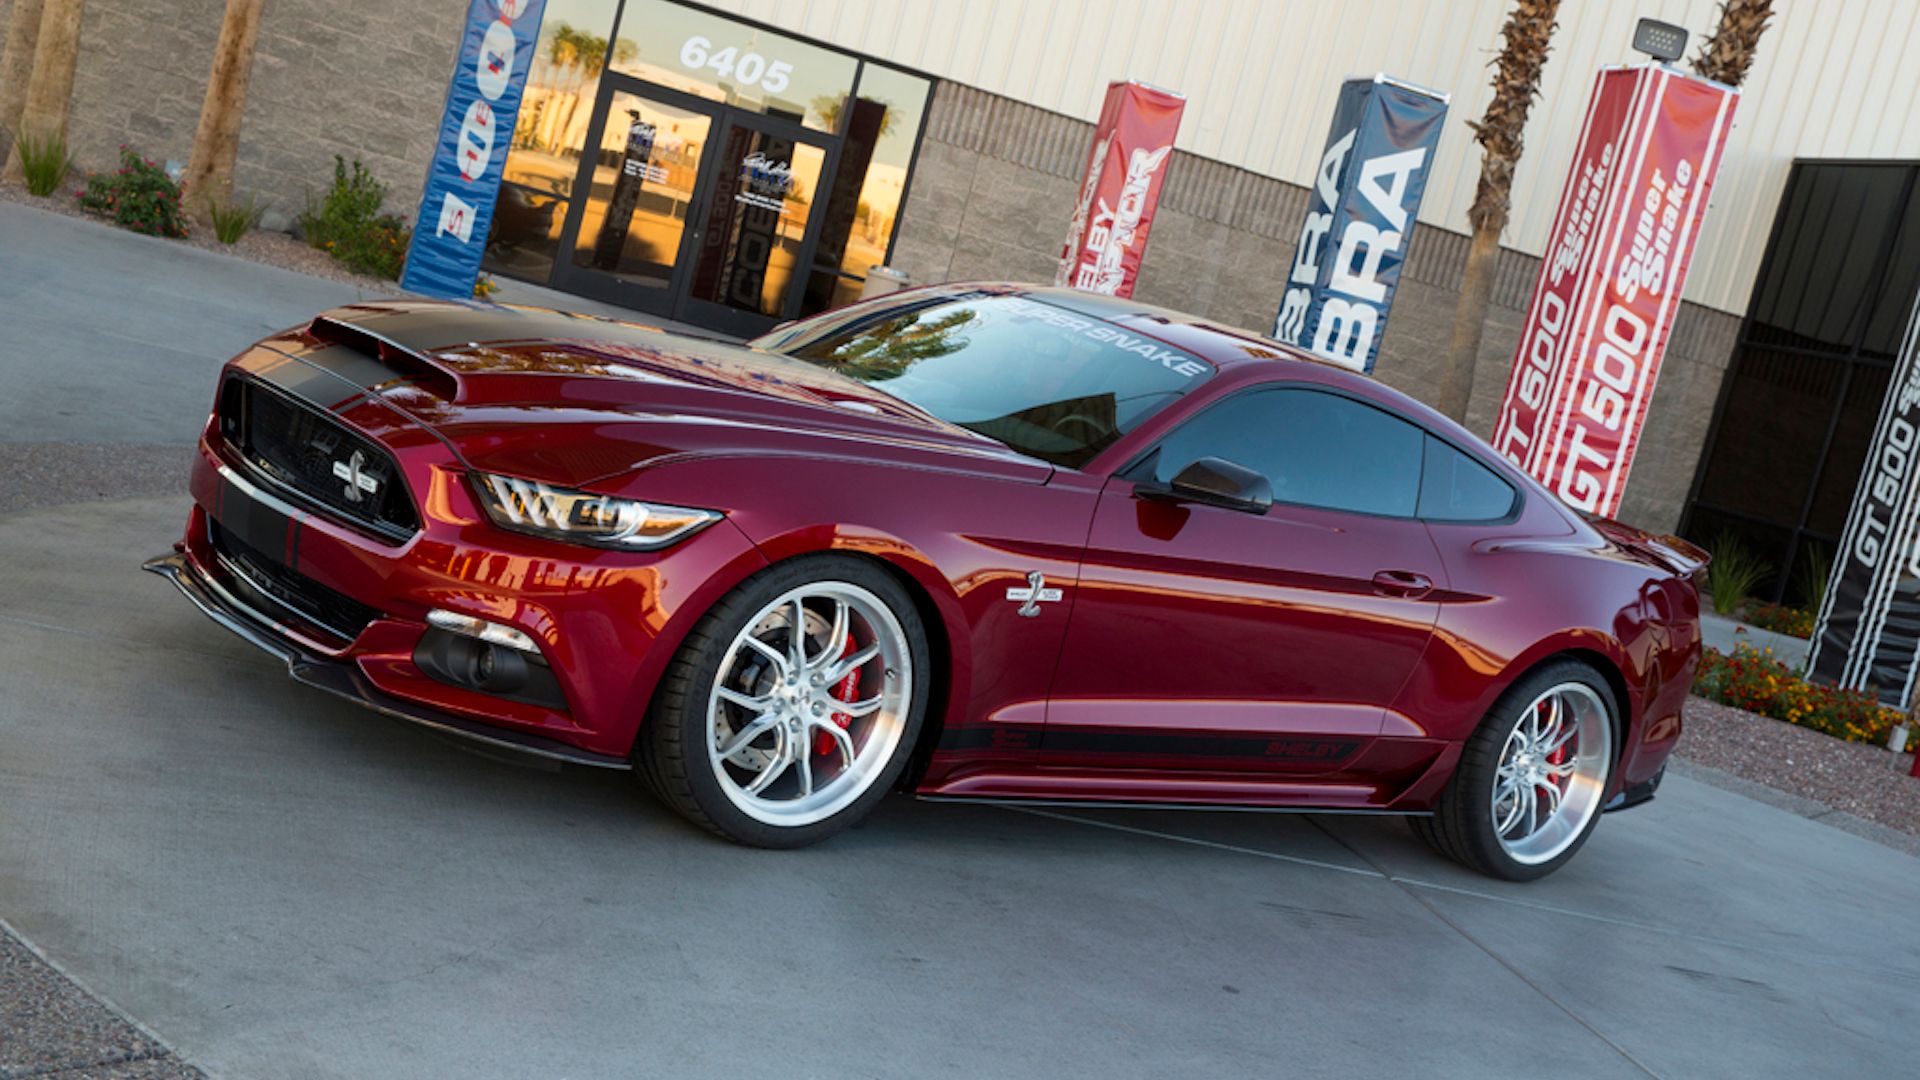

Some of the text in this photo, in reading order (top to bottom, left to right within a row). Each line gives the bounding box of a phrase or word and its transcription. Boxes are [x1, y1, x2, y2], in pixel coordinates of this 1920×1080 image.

[680, 36, 793, 93] 6405
[1275, 127, 1357, 346] BRA
[1312, 147, 1427, 373] BRA
[1518, 290, 1566, 411] 500
[1551, 158, 1594, 288] Super
[1566, 143, 1613, 276] Snake
[1641, 159, 1692, 296] Snake
[994, 299, 1208, 377] SUPER SNAKE
[1558, 168, 1666, 513] GT 500 Super
[1855, 503, 1887, 569] GT
[1872, 417, 1916, 508] 500
